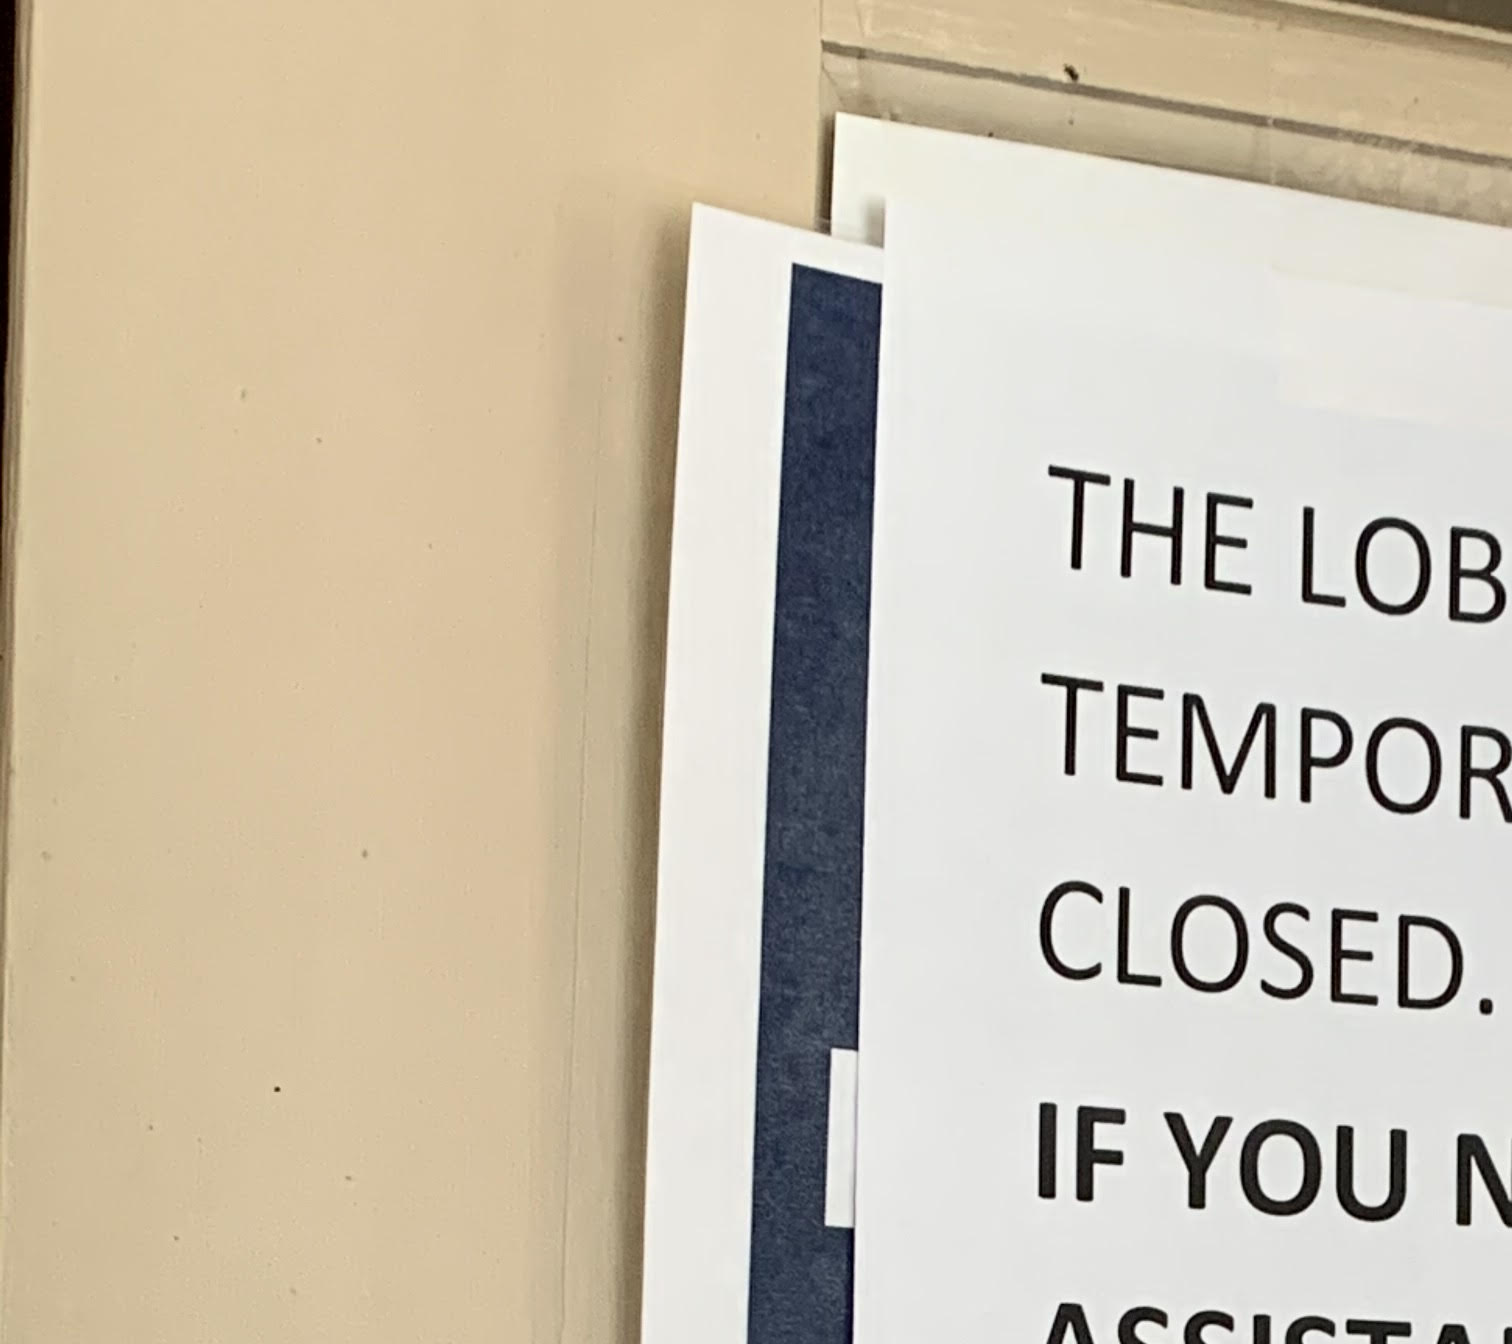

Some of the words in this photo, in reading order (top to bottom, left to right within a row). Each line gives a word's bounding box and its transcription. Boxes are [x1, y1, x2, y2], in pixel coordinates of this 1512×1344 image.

[1045, 462, 1256, 599] THE
[1036, 877, 1497, 1018] CLOSED.
[1035, 1099, 1129, 1205] IF
[1160, 1108, 1410, 1225] YOU
